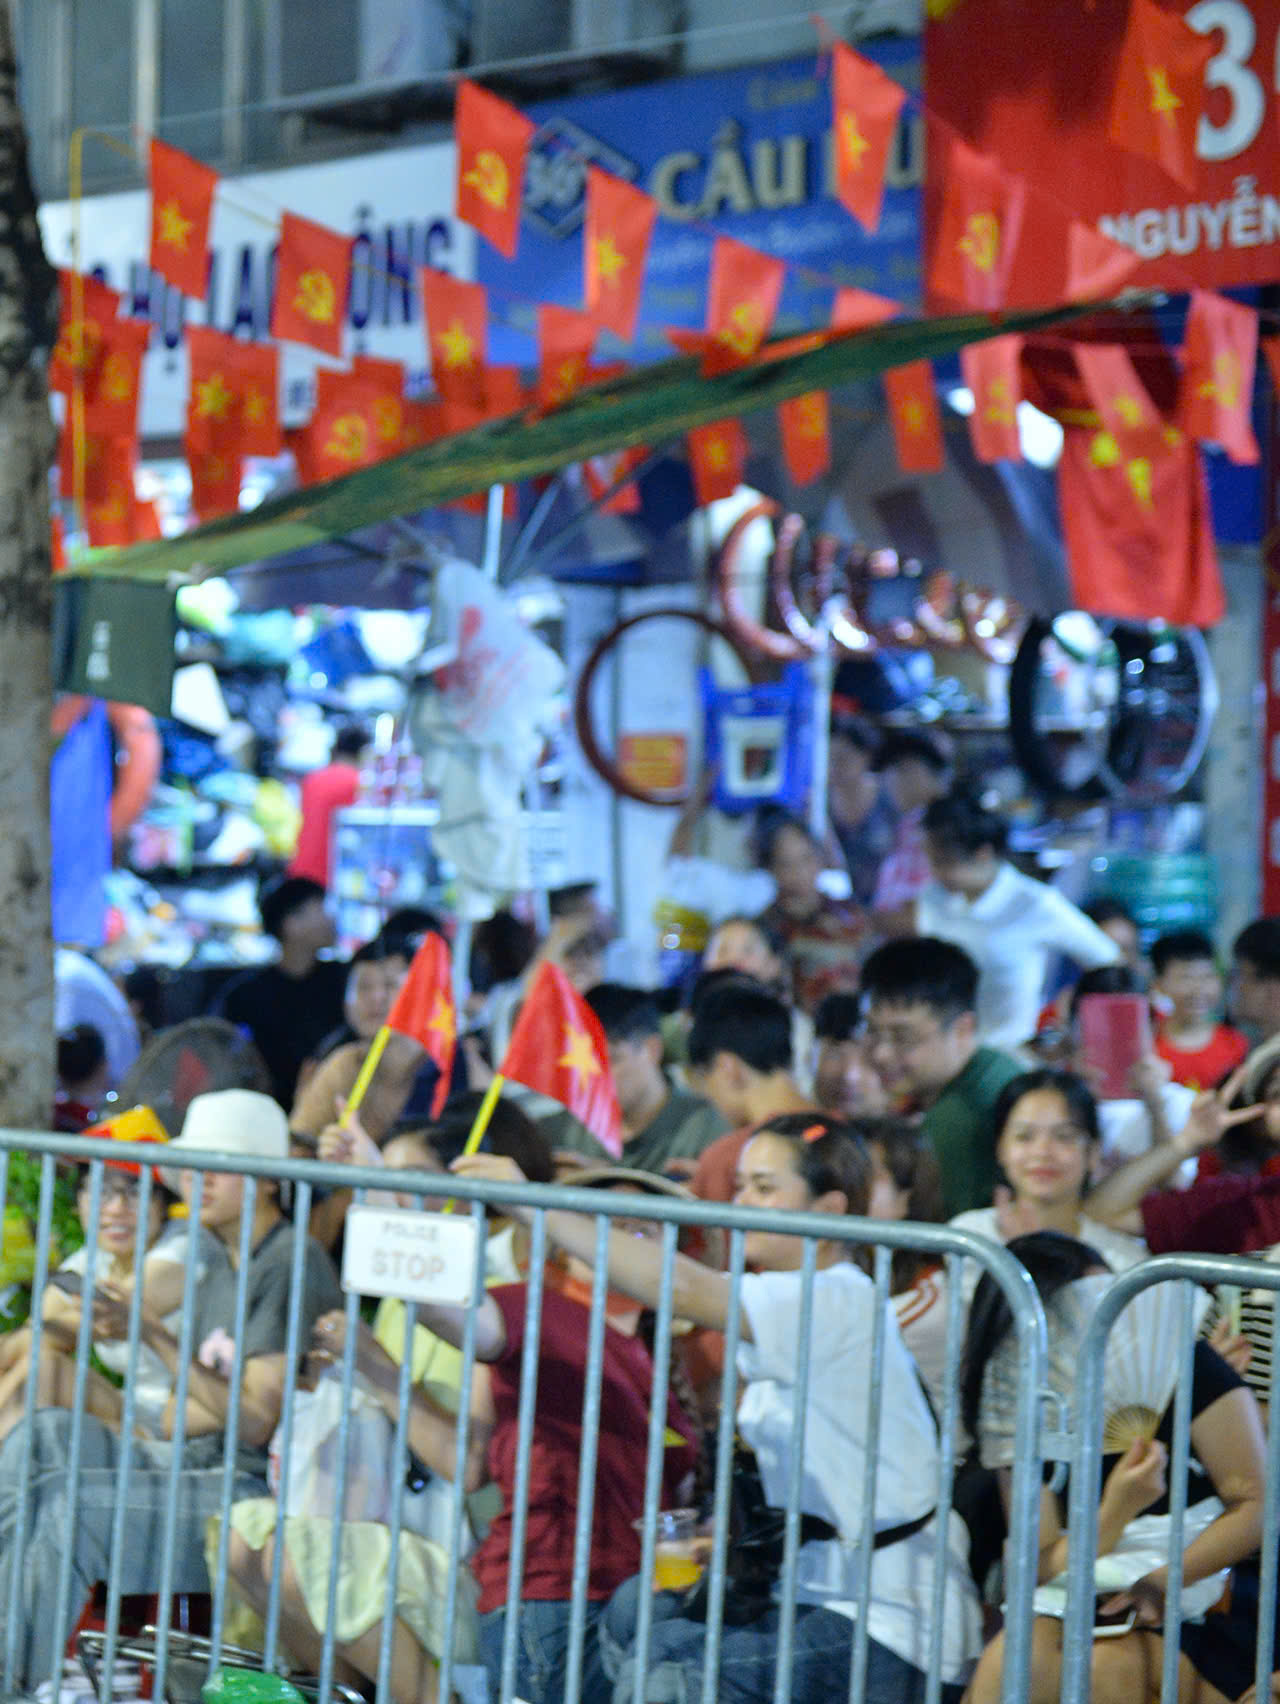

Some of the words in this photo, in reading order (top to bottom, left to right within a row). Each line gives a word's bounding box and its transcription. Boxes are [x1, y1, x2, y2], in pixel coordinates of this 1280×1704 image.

[1184, 0, 1280, 162] 3
[384, 1221, 440, 1241] POLICE
[373, 1248, 446, 1282] STOP
